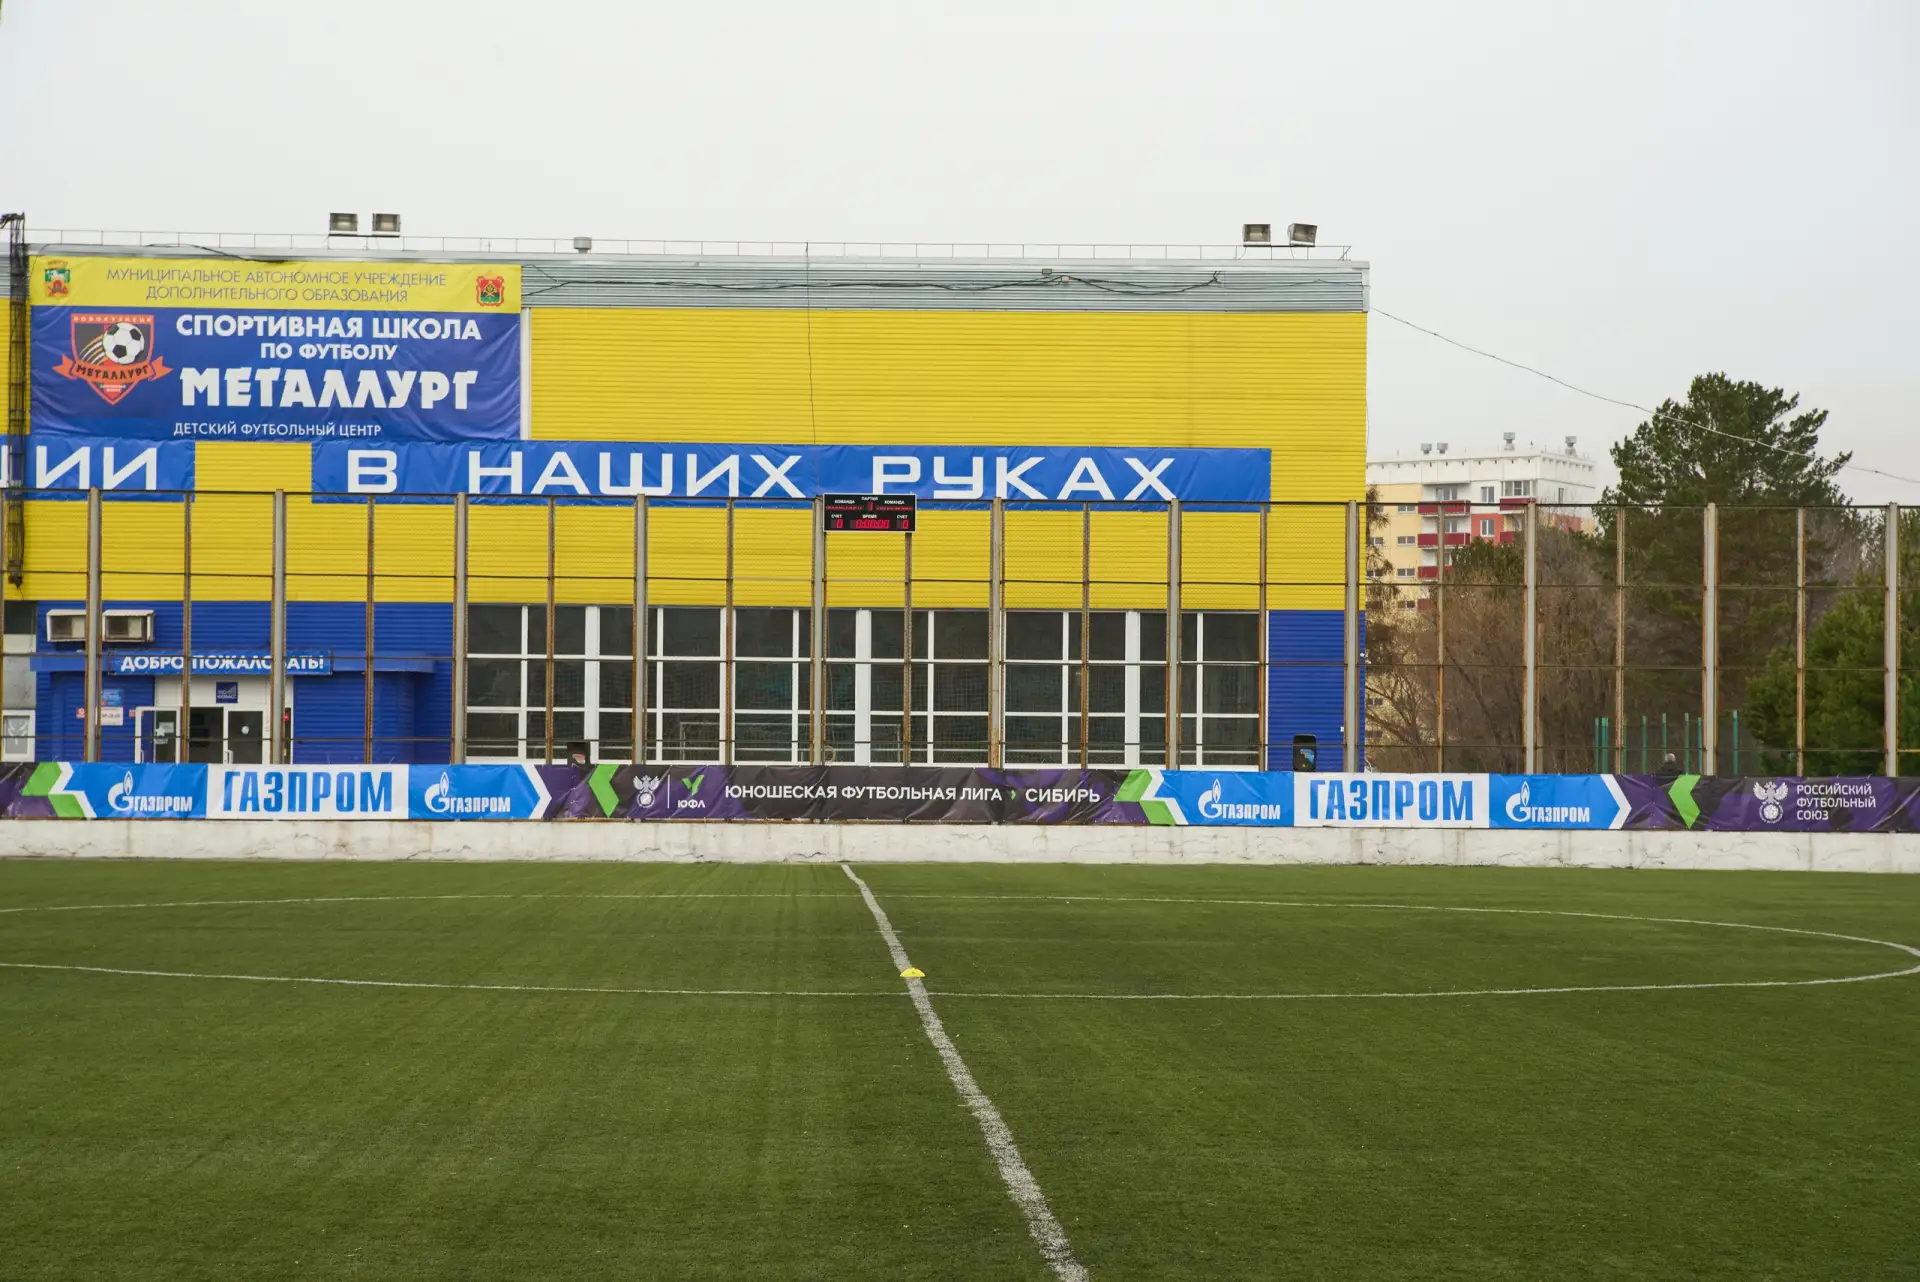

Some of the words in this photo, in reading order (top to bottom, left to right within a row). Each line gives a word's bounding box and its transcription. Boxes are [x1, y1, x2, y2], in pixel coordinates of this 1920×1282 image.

[107, 268, 241, 286] МУНИЦИПАЛЬНОЕ
[245, 271, 349, 285] АВТОНОМНОЕ
[354, 272, 447, 288] УЧРЕЖДЕНИЕ
[145, 286, 298, 301] ДОПОЛНИТЕЛЬНОГО
[302, 289, 408, 303] ОБРАЗОВАНИЯ
[176, 314, 363, 339] СПОРТИВНАЯ
[372, 318, 482, 341] ШКОЛА
[260, 343, 292, 359] ПО
[299, 343, 399, 361] ФУТБОЛУ
[75, 363, 150, 380] МЕТАЛЛУРГ
[180, 366, 478, 410] МЕТАЛЛУРГ
[173, 422, 237, 437] ДЕТСКИЙ
[240, 421, 336, 437] ФУТБОЛЬНЫЙ
[339, 424, 381, 438] ЦЕНТР
[347, 450, 398, 494] В
[468, 451, 808, 498] НАШИХ
[872, 455, 1177, 501] РУКАХ
[120, 656, 184, 672] ДОБРО
[192, 655, 324, 670] ПОЖАЛОАТЬ!
[223, 771, 393, 812] ГАЗПРОМ
[725, 785, 837, 799] ЮНОШЕСКАЯ
[841, 784, 957, 801] ФУТБОЛЬНАЯ
[960, 787, 1003, 802] ЛИГА
[1025, 788, 1101, 803] СИБИРЬ
[1797, 784, 1872, 795] РОССИЙСКИЙ
[134, 795, 193, 812] ГАЗПРОМ
[450, 797, 511, 813] ГАЗПРОМ
[677, 799, 706, 809] ЮФЛ
[1310, 779, 1473, 821] ГАЗПРОМ
[1797, 796, 1876, 808] ФУТБОЛЬНЫЙ
[1221, 803, 1281, 820] ГАЗПРОМ
[1530, 806, 1590, 823] ГАЗПРОМ
[1797, 810, 1829, 820] СОЮЗ
